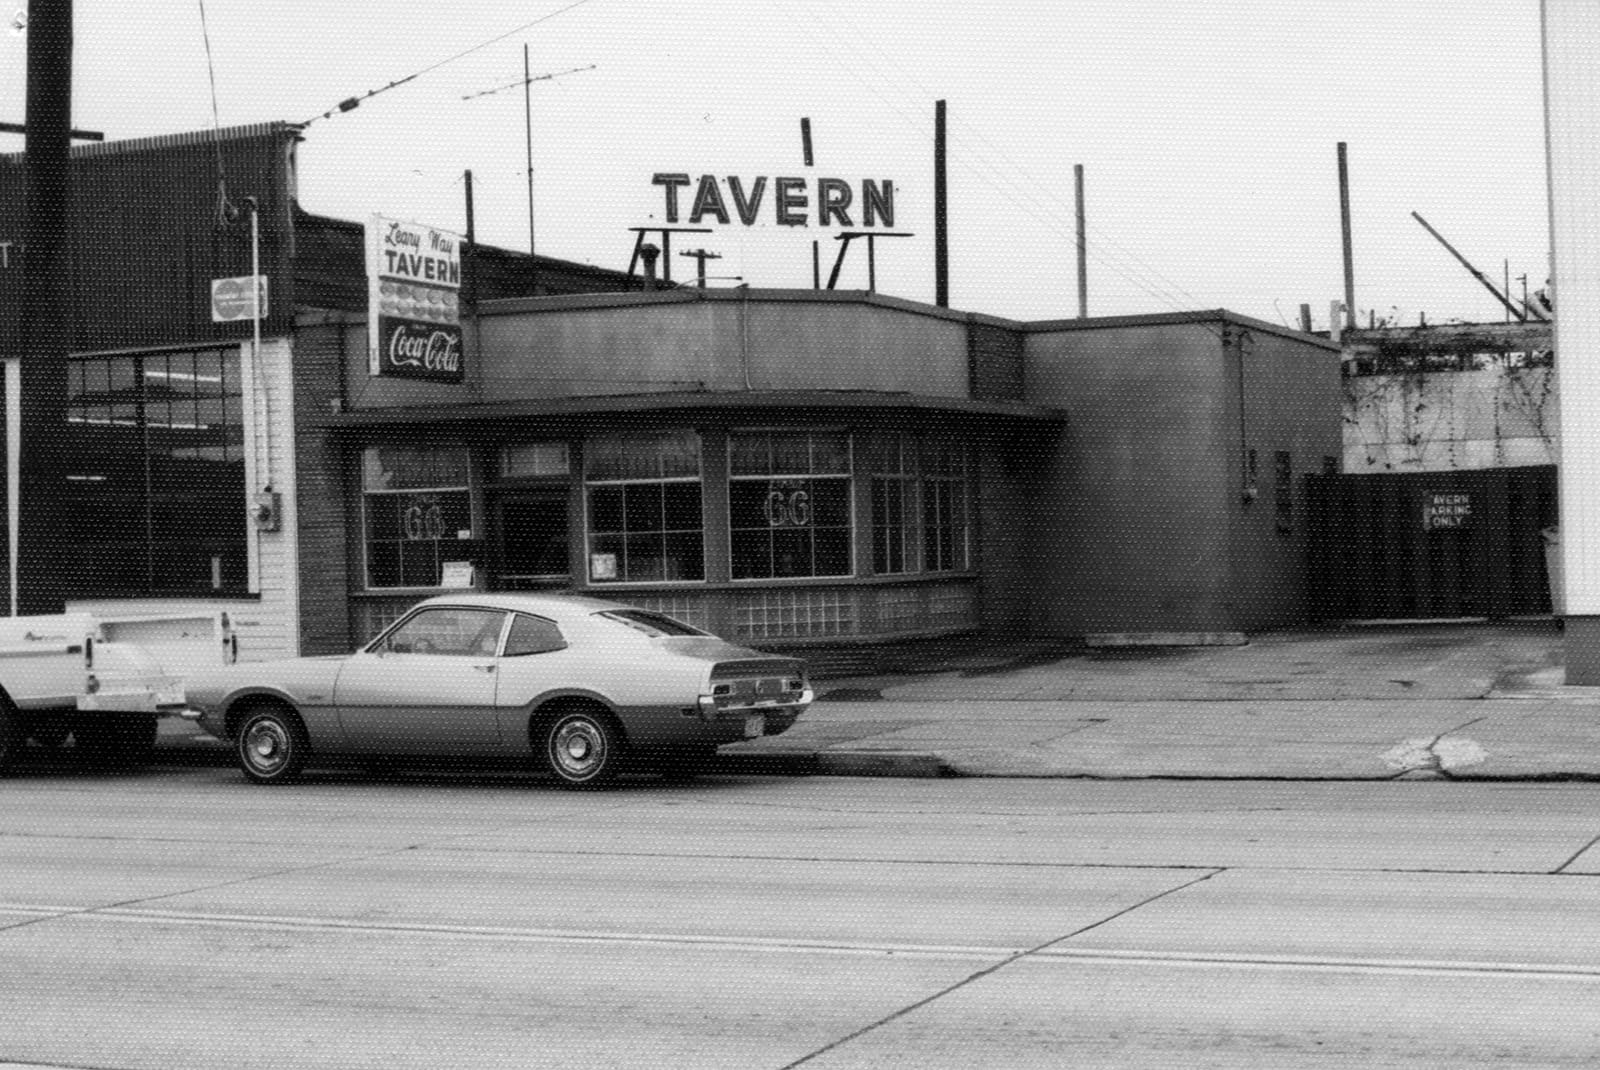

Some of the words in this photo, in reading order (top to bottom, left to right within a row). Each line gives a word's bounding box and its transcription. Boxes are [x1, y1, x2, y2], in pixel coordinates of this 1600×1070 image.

[651, 172, 895, 228] TAVERN
[385, 222, 421, 253] Leary
[428, 230, 454, 254] Way
[385, 249, 459, 284] TAVERN
[1432, 516, 1464, 527] ONLY
